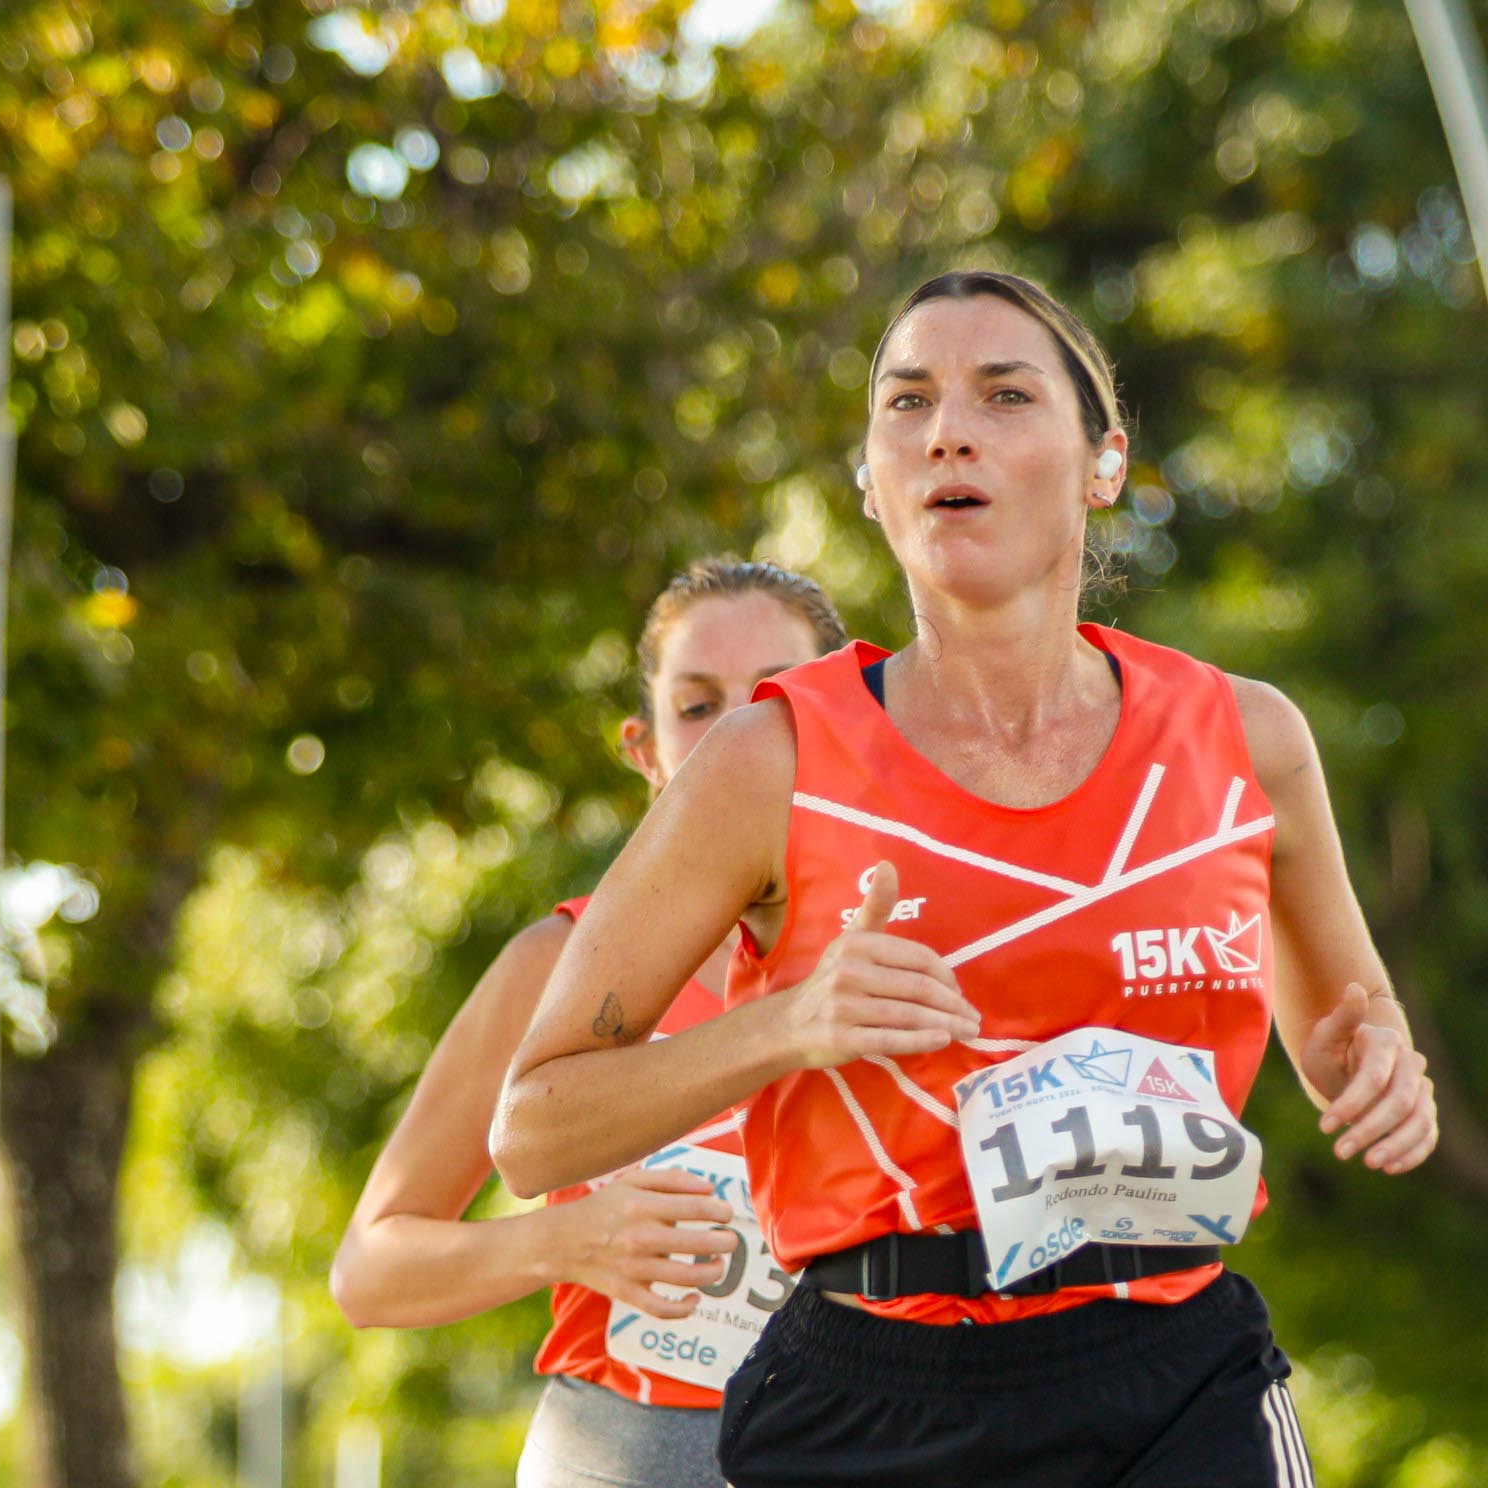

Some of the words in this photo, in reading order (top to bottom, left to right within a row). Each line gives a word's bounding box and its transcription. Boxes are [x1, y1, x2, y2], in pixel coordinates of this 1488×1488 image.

[1111, 926, 1206, 981] 15K
[1123, 980, 1204, 999] PUERTO
[1212, 977, 1265, 991] NORTE
[983, 1057, 1064, 1108] 15K
[1145, 1074, 1182, 1096] 15K
[979, 1104, 1247, 1203] 1119
[1044, 1183, 1109, 1210] Redondo
[1112, 1183, 1177, 1202] Paulina
[1029, 1216, 1086, 1268] osde
[640, 1329, 718, 1366] osde
